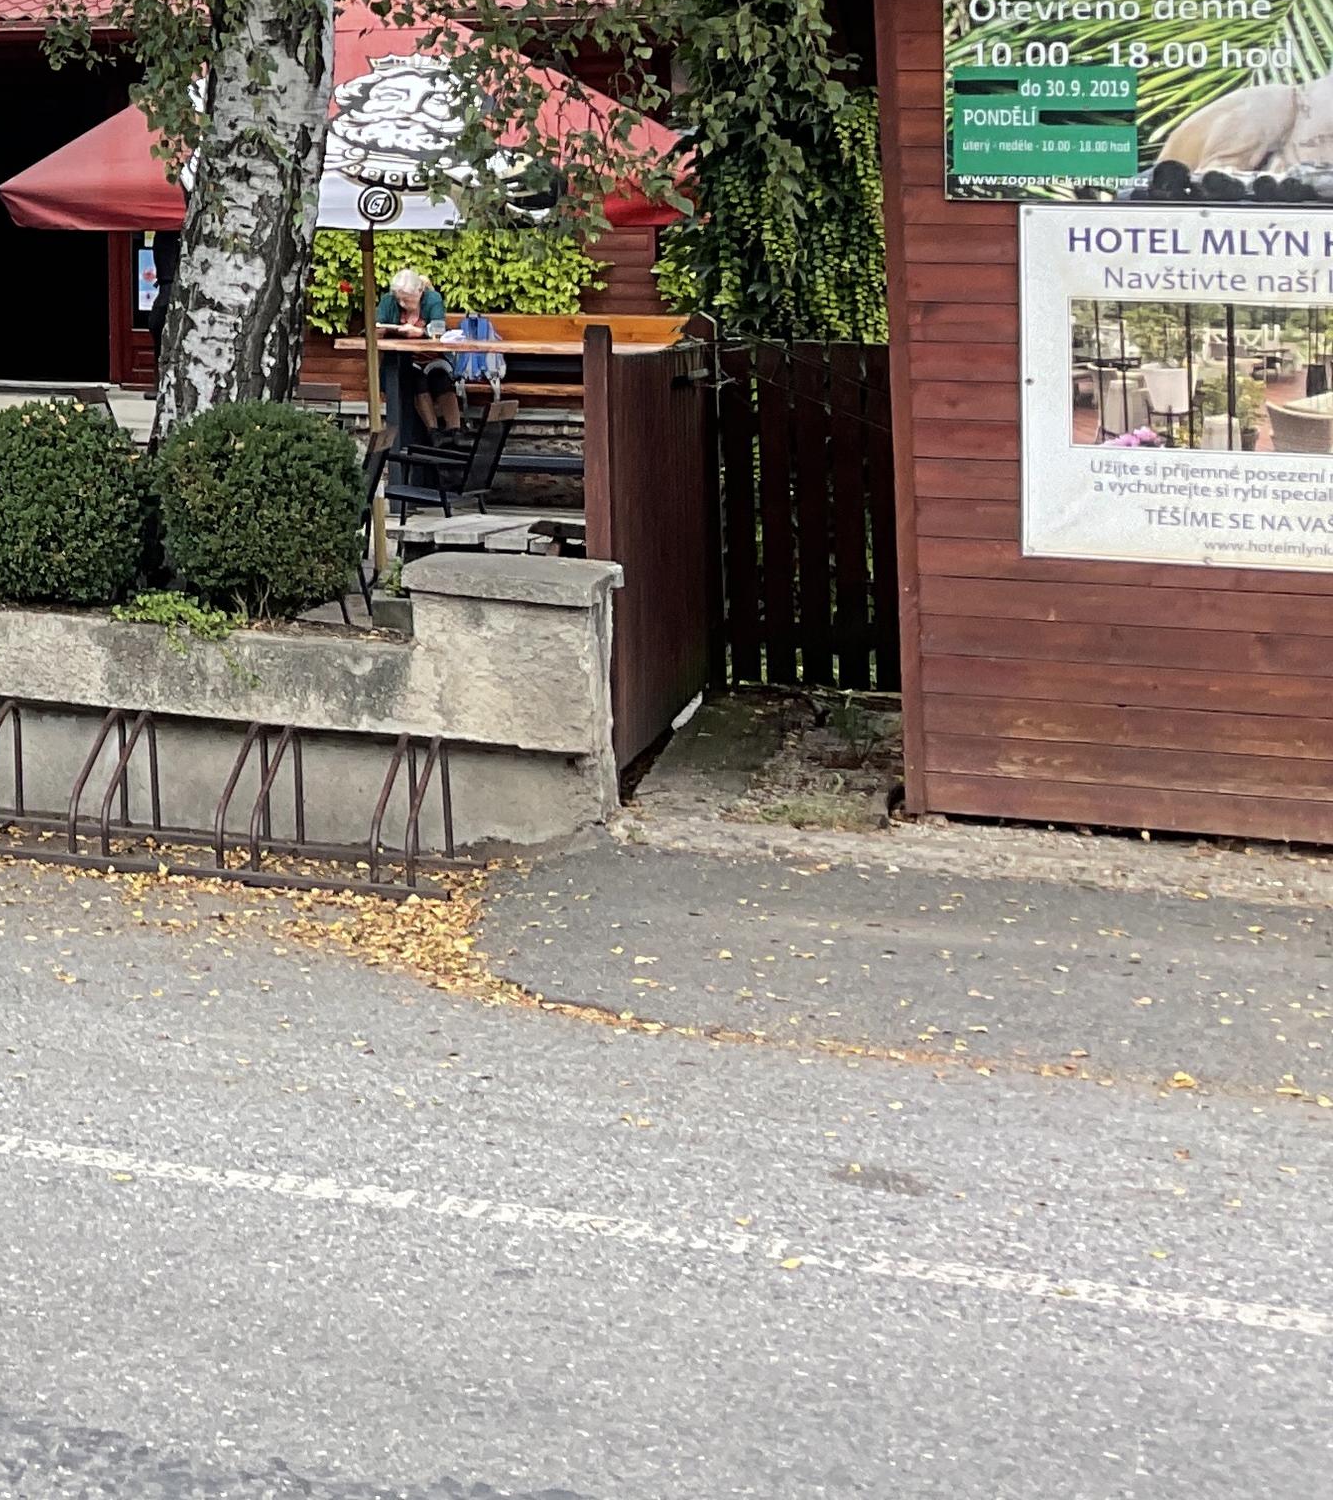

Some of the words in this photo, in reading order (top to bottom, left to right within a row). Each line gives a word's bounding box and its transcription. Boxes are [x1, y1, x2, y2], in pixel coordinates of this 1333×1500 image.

[972, 41, 1069, 67] 10.00
[1107, 41, 1208, 68] 18.00
[1221, 39, 1293, 68] hod
[1020, 79, 1041, 97] do
[1090, 80, 1130, 97] 2019
[963, 105, 1038, 126] PONDĚLÍ
[1067, 227, 1191, 254] HOTEL
[1201, 223, 1310, 257] MLÝN
[1104, 266, 1247, 291] Navštivte
[1257, 268, 1319, 293] naší
[1090, 459, 1141, 478] Užijte
[1144, 462, 1157, 476] si
[1162, 463, 1240, 481] příjemné
[1244, 468, 1325, 484] posezení
[1093, 481, 1103, 491] a
[1108, 480, 1211, 499] vychutnejte
[1215, 483, 1229, 497] si
[1234, 484, 1268, 502] rybí
[1144, 506, 1223, 528] TĚŠÍME
[1229, 513, 1254, 530] SE
[1261, 514, 1293, 531] NA
